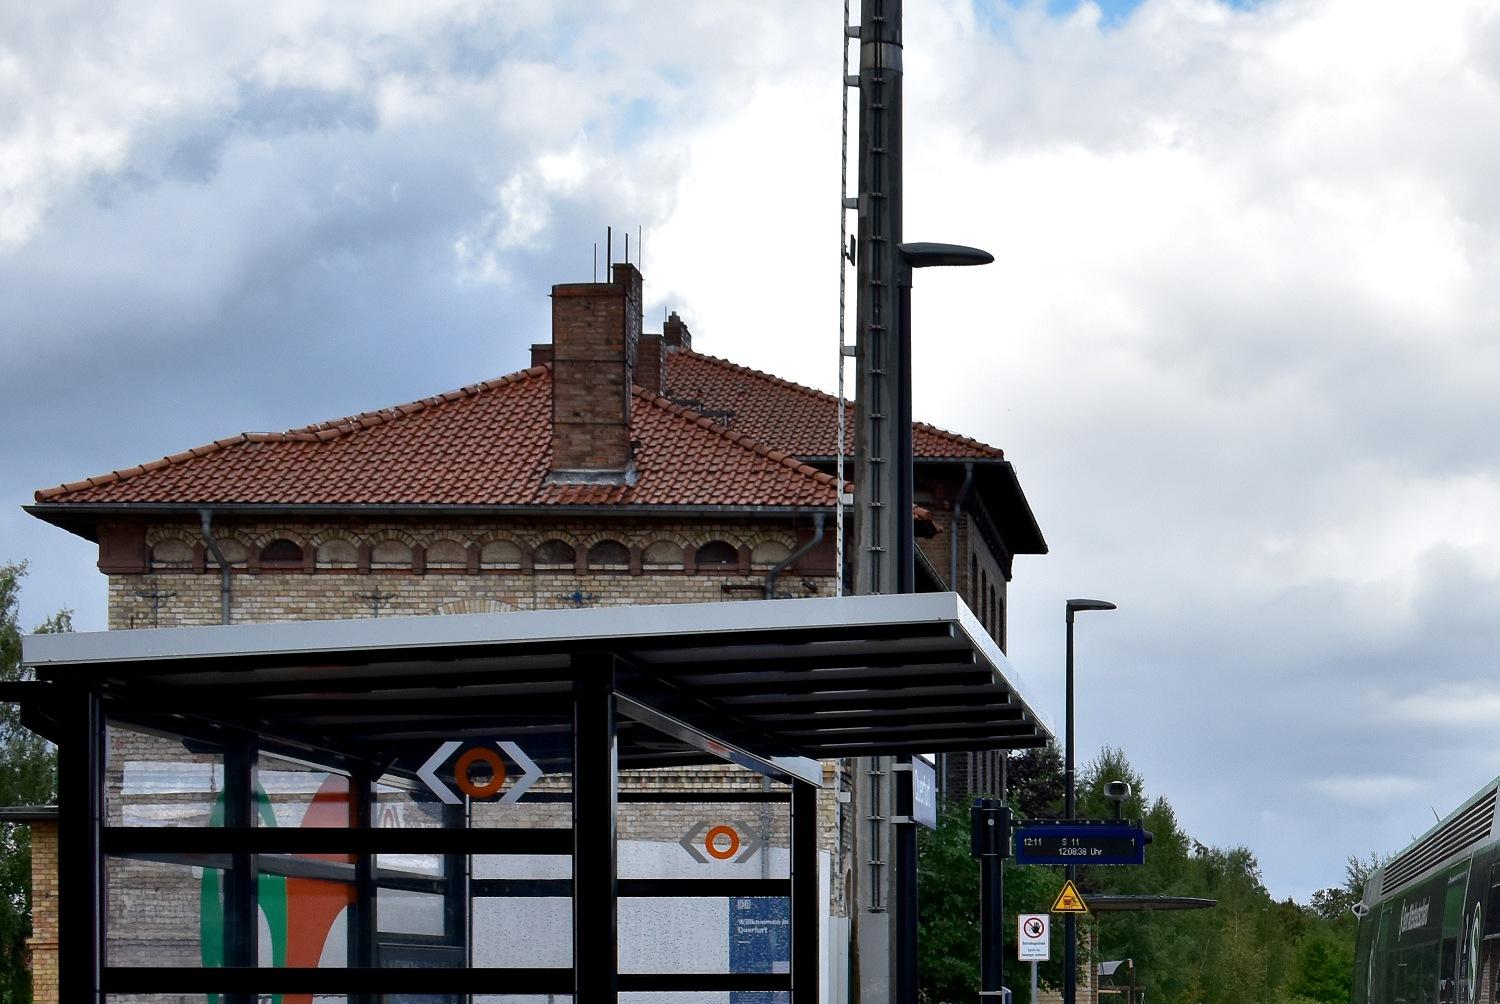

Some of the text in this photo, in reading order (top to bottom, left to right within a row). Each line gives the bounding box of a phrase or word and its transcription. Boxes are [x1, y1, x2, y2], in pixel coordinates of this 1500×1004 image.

[1023, 838, 1042, 846] 12:11
[1061, 838, 1067, 846] S
[1071, 838, 1080, 846] 11
[1059, 847, 1103, 856] 12:08:38 Uhr
